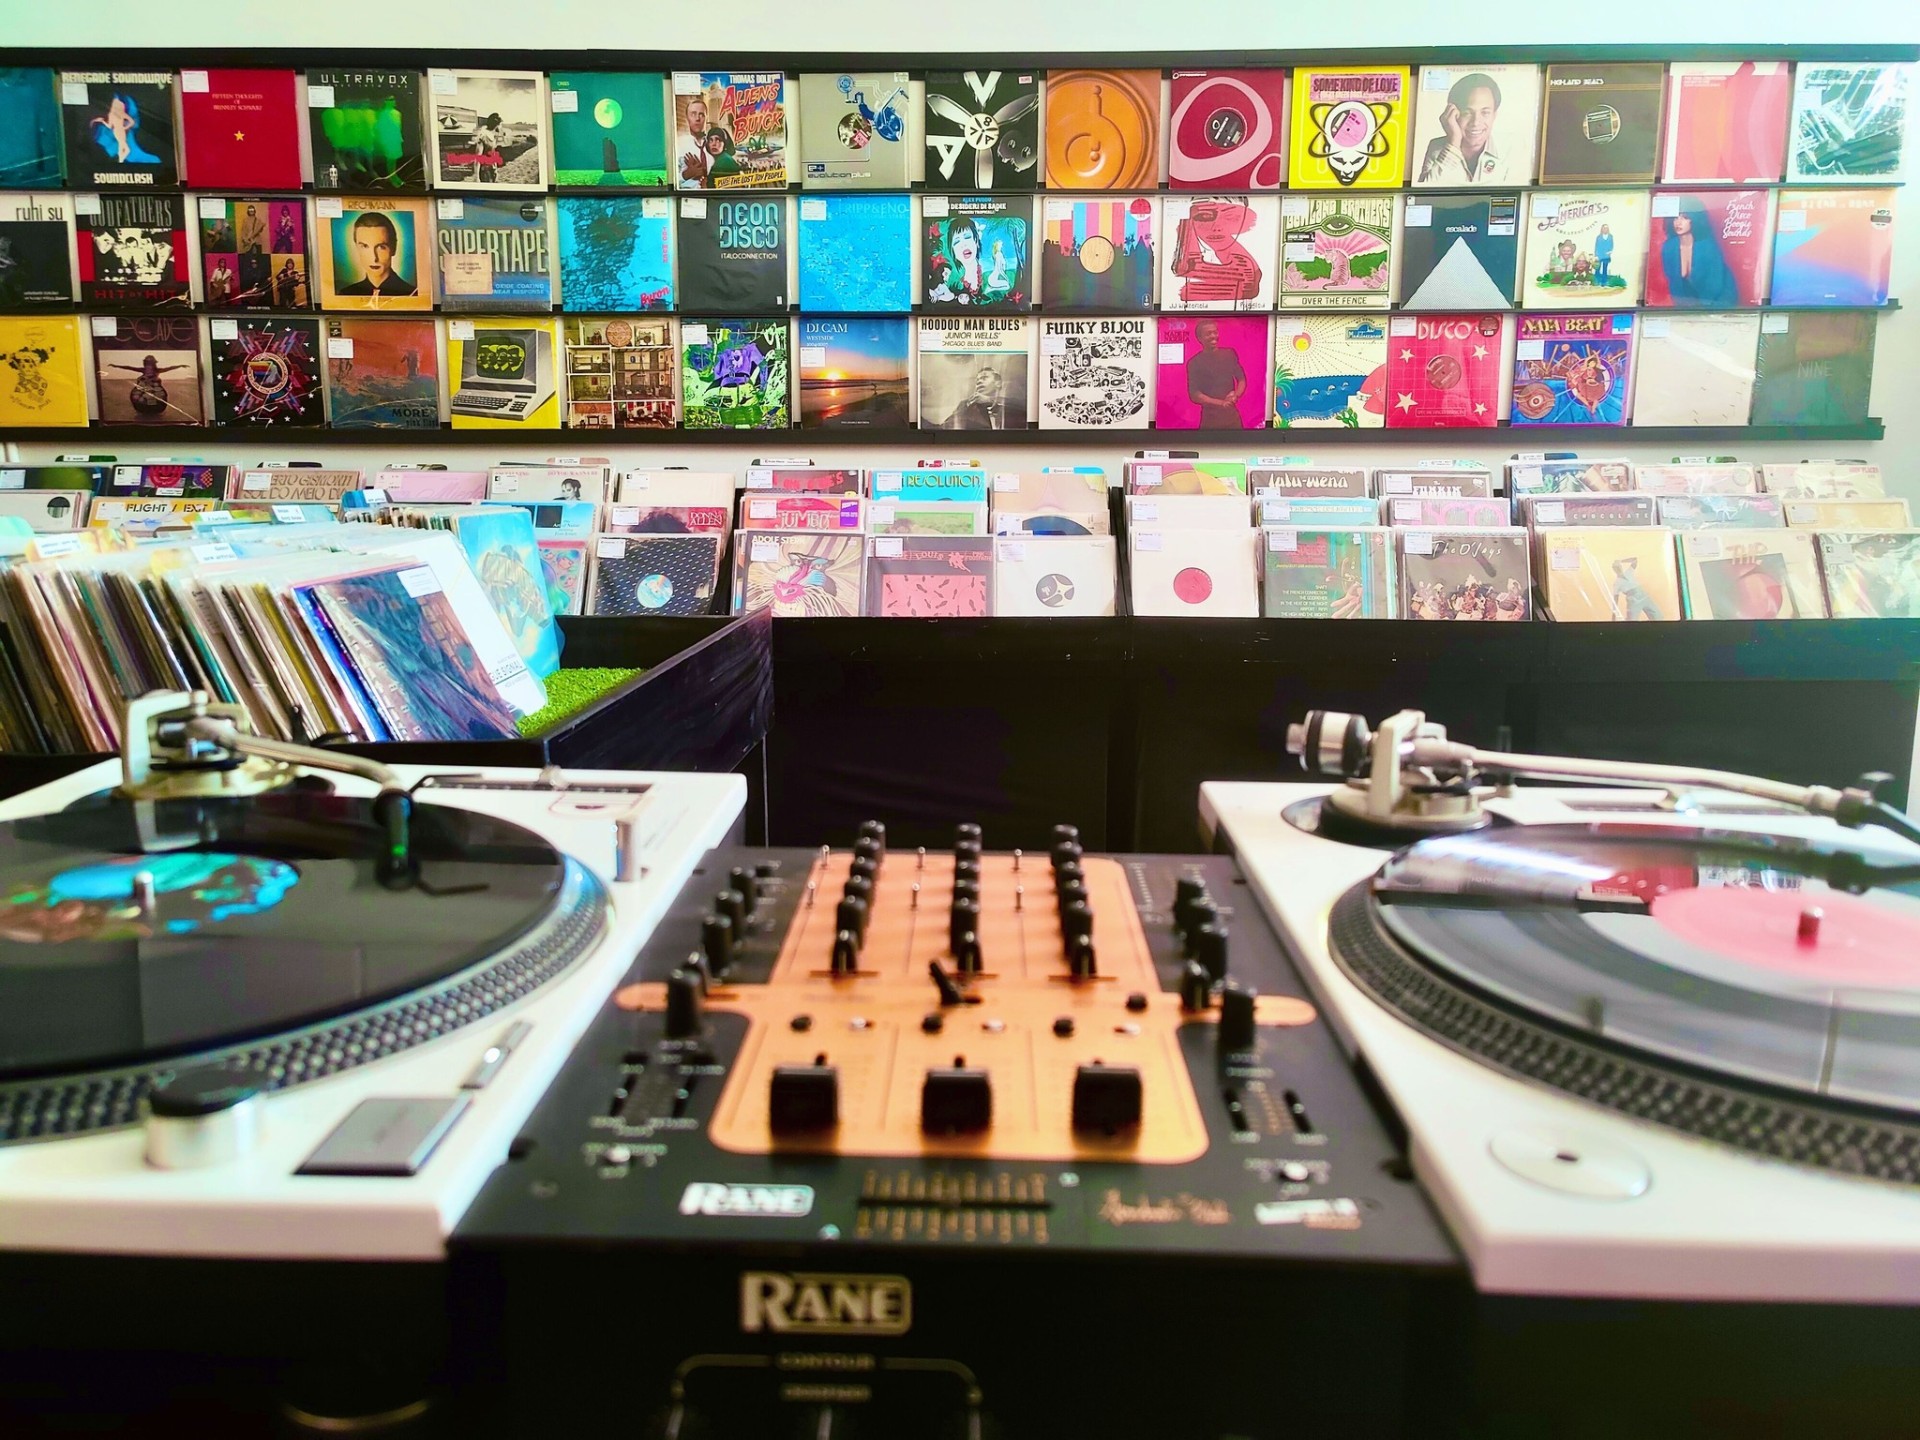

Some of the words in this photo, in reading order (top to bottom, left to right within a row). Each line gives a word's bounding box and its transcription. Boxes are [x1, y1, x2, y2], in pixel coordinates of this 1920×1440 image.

[61, 72, 111, 84] RENEGADE
[112, 72, 173, 85] SOUNDWAVE
[320, 73, 408, 85] ULTRAVOX
[729, 74, 755, 84] THOMAS
[719, 83, 780, 121] ALIENS
[733, 111, 785, 147] BUICK
[94, 172, 154, 185] SOUNDCLASH
[15, 196, 43, 221] ruhi
[48, 206, 63, 221] su
[1726, 199, 1755, 211] French
[719, 202, 779, 226] NEON
[1445, 224, 1478, 233] escalade
[719, 226, 779, 249] DISCO
[438, 229, 547, 273] SUPERTAPE
[720, 252, 778, 260] ITALOCONNECTION
[95, 289, 125, 300] HIT
[1302, 296, 1324, 305] OVER
[1326, 297, 1341, 305] THE
[1342, 296, 1367, 305] FENCE
[806, 322, 820, 333] DJ
[821, 322, 848, 333] CAM
[921, 319, 960, 331] HOODOO
[963, 319, 985, 331] MAN
[988, 319, 1020, 331] BLUES
[1045, 321, 1096, 335] FUNKY
[1100, 320, 1145, 335] BIJOU
[1417, 320, 1473, 340] DISCO
[1521, 317, 1562, 333] NAYA
[1565, 317, 1609, 333] BEAT
[944, 331, 972, 340] JUNIOR
[1797, 361, 1833, 377] NINE
[391, 408, 430, 418] MORE
[126, 503, 167, 513] FLIGHT
[183, 503, 208, 513] EXIT
[689, 511, 722, 519] DONNA
[689, 518, 722, 526] ALLEN
[680, 1182, 815, 1217] RANE
[740, 1270, 904, 1334] RANE
